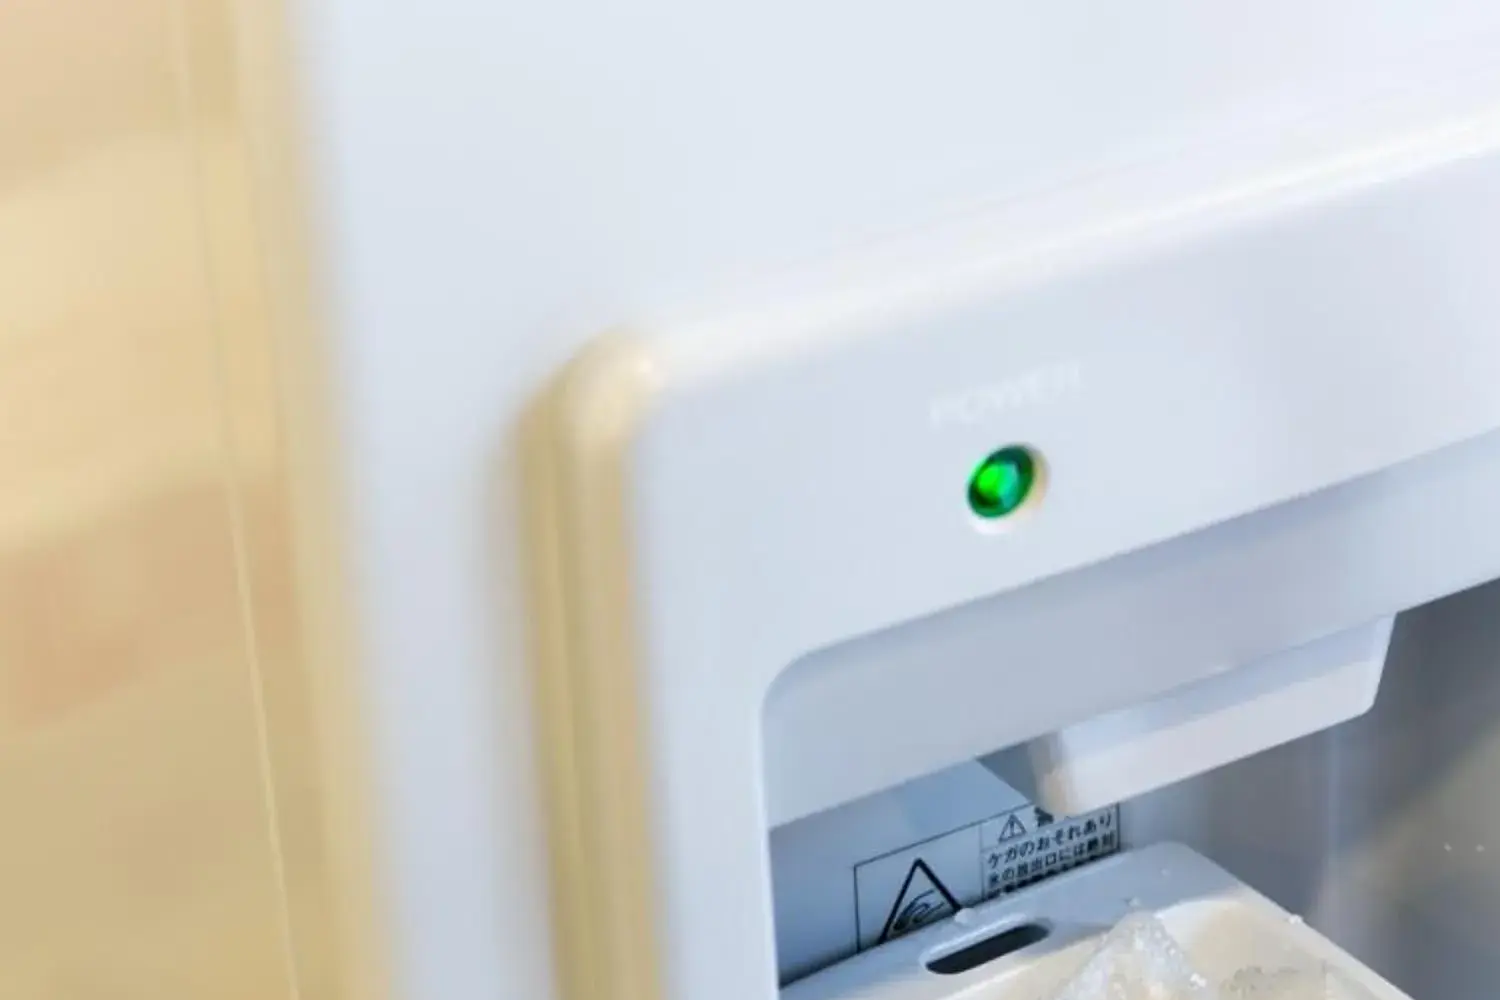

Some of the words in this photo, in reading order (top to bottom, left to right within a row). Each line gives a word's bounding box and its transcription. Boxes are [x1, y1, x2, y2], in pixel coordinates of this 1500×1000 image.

[988, 811, 1112, 868] ケガのおそれあり
